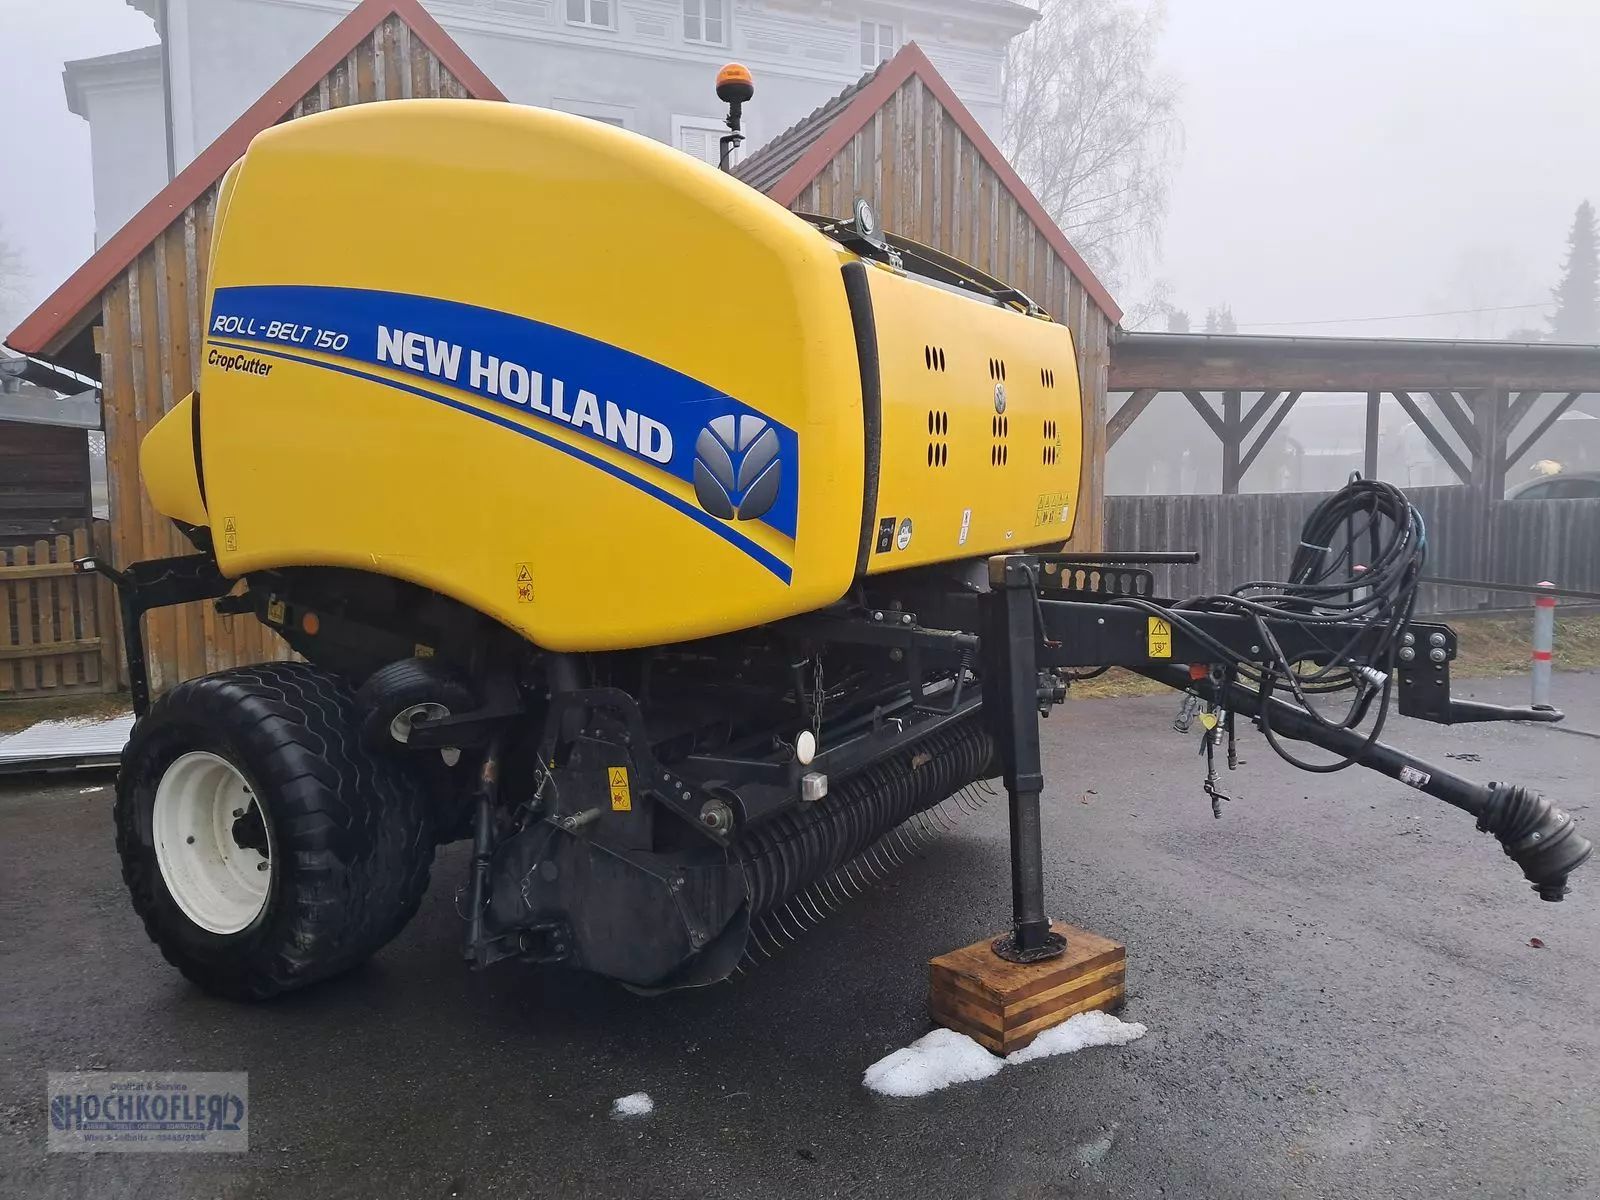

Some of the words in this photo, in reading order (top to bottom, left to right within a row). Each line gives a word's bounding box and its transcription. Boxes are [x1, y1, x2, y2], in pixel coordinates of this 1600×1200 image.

[313, 329, 349, 350] 150
[208, 349, 273, 376] CropCutter
[377, 325, 462, 381] NEW
[470, 350, 673, 464] HOLLAND
